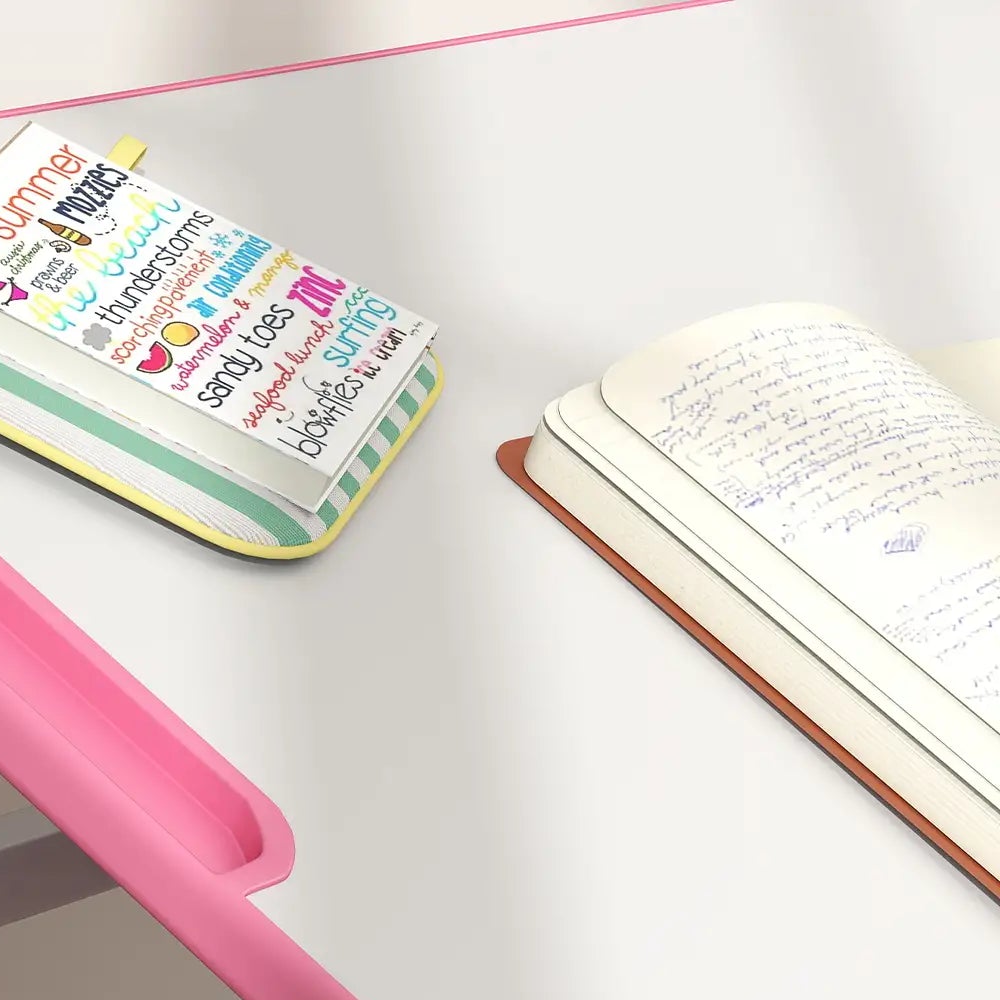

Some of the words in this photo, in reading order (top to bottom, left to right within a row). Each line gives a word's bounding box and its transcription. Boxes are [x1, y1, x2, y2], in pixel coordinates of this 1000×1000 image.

[52, 163, 129, 224] mozzies
[28, 280, 97, 332] the
[75, 193, 181, 277] beach
[30, 257, 65, 290] prawns
[56, 263, 79, 290] beer
[94, 210, 214, 325] thunderstorms
[186, 297, 218, 319] air
[203, 234, 273, 298] conditioning
[171, 311, 241, 392] watermelon
[233, 298, 250, 310] &
[198, 349, 263, 408] sandy
[238, 303, 295, 349] toes
[242, 362, 296, 429] seafood
[284, 320, 334, 365] lunch
[323, 296, 397, 368] surfing
[277, 375, 364, 459] blowflies
